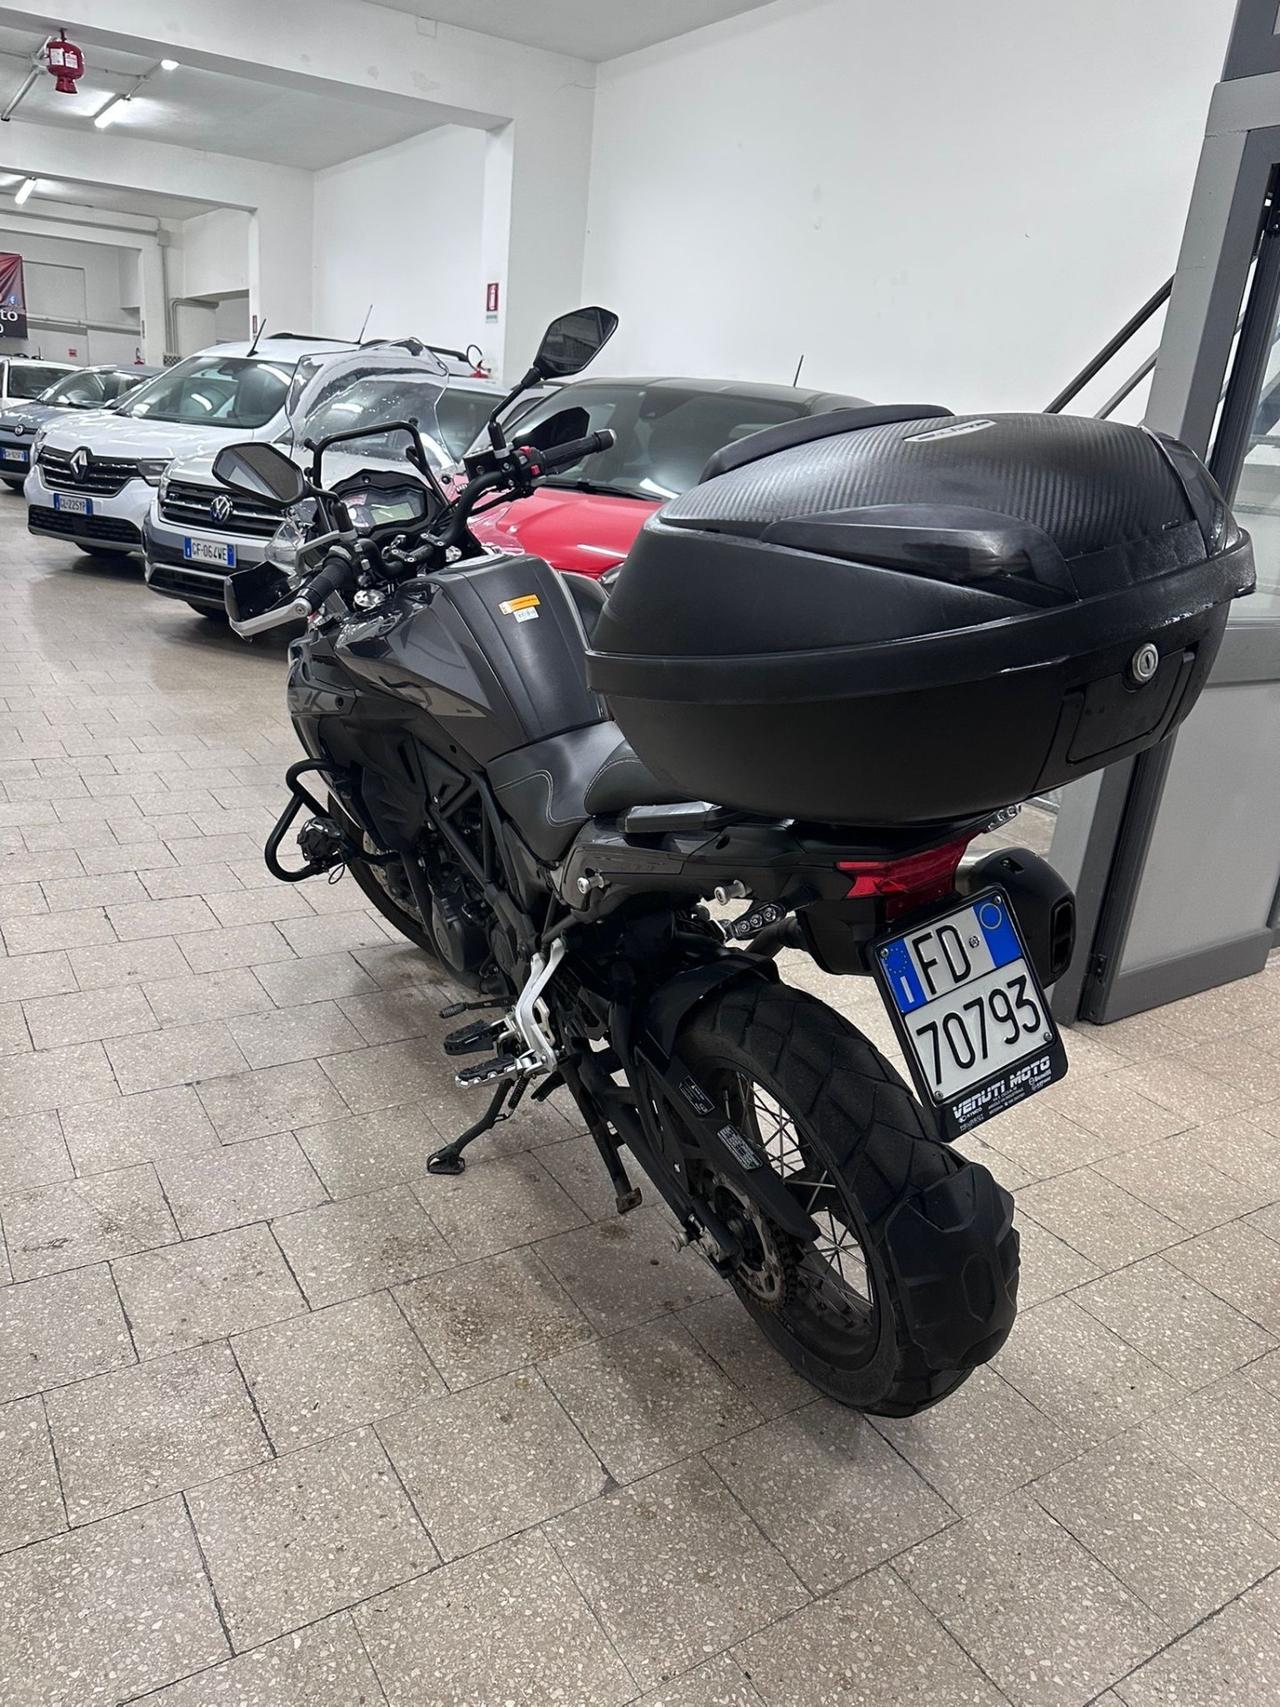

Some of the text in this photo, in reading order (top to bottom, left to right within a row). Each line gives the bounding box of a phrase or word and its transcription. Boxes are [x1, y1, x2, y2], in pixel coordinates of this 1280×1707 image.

[911, 924, 972, 995] FD
[916, 974, 1041, 1086] 70793
[953, 1080, 1005, 1118] VENUTI
[1010, 1056, 1050, 1088] MOTO
